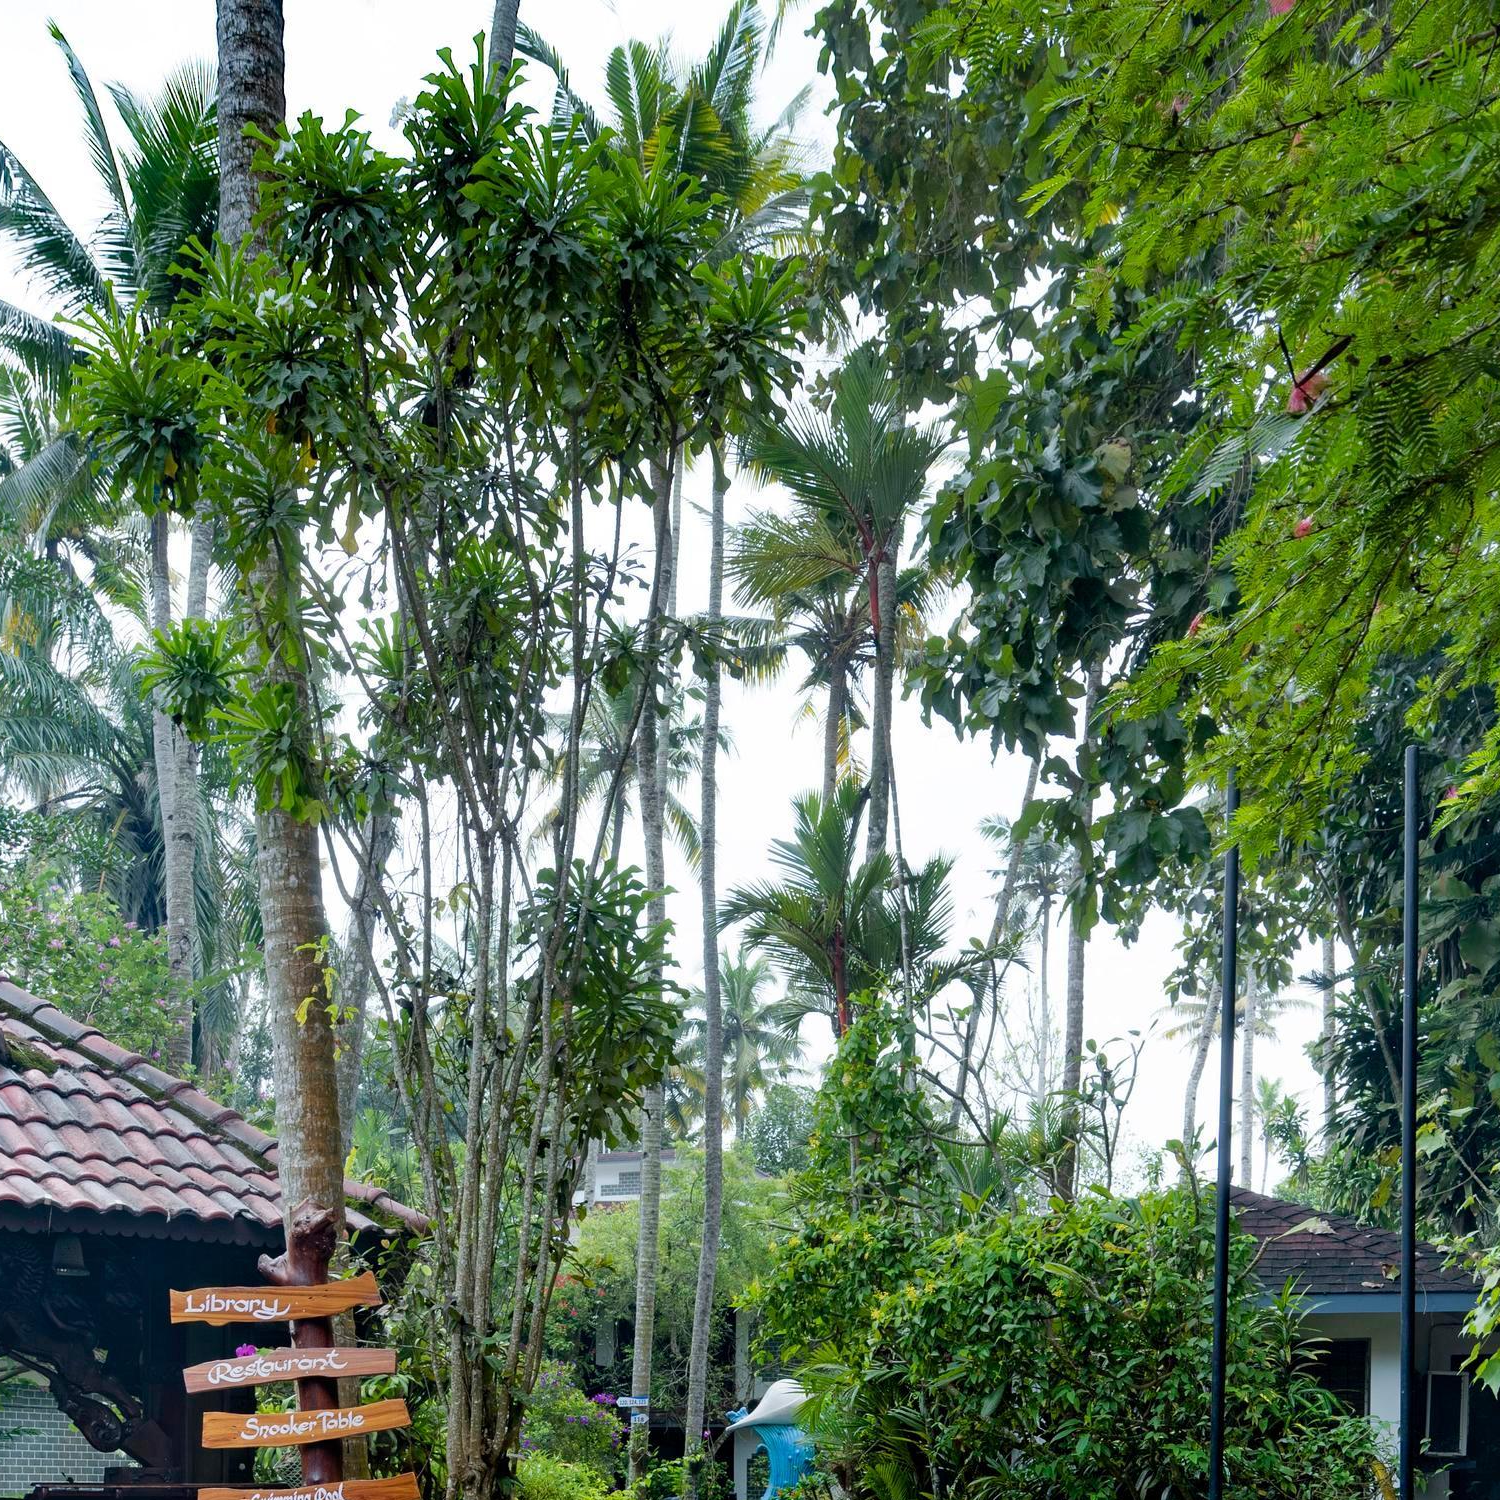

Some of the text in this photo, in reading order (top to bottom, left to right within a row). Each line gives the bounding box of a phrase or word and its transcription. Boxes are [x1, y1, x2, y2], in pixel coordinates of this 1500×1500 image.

[184, 1293, 291, 1320] Library
[207, 1349, 348, 1385] Restaurant
[240, 1410, 365, 1441] Snooker Table
